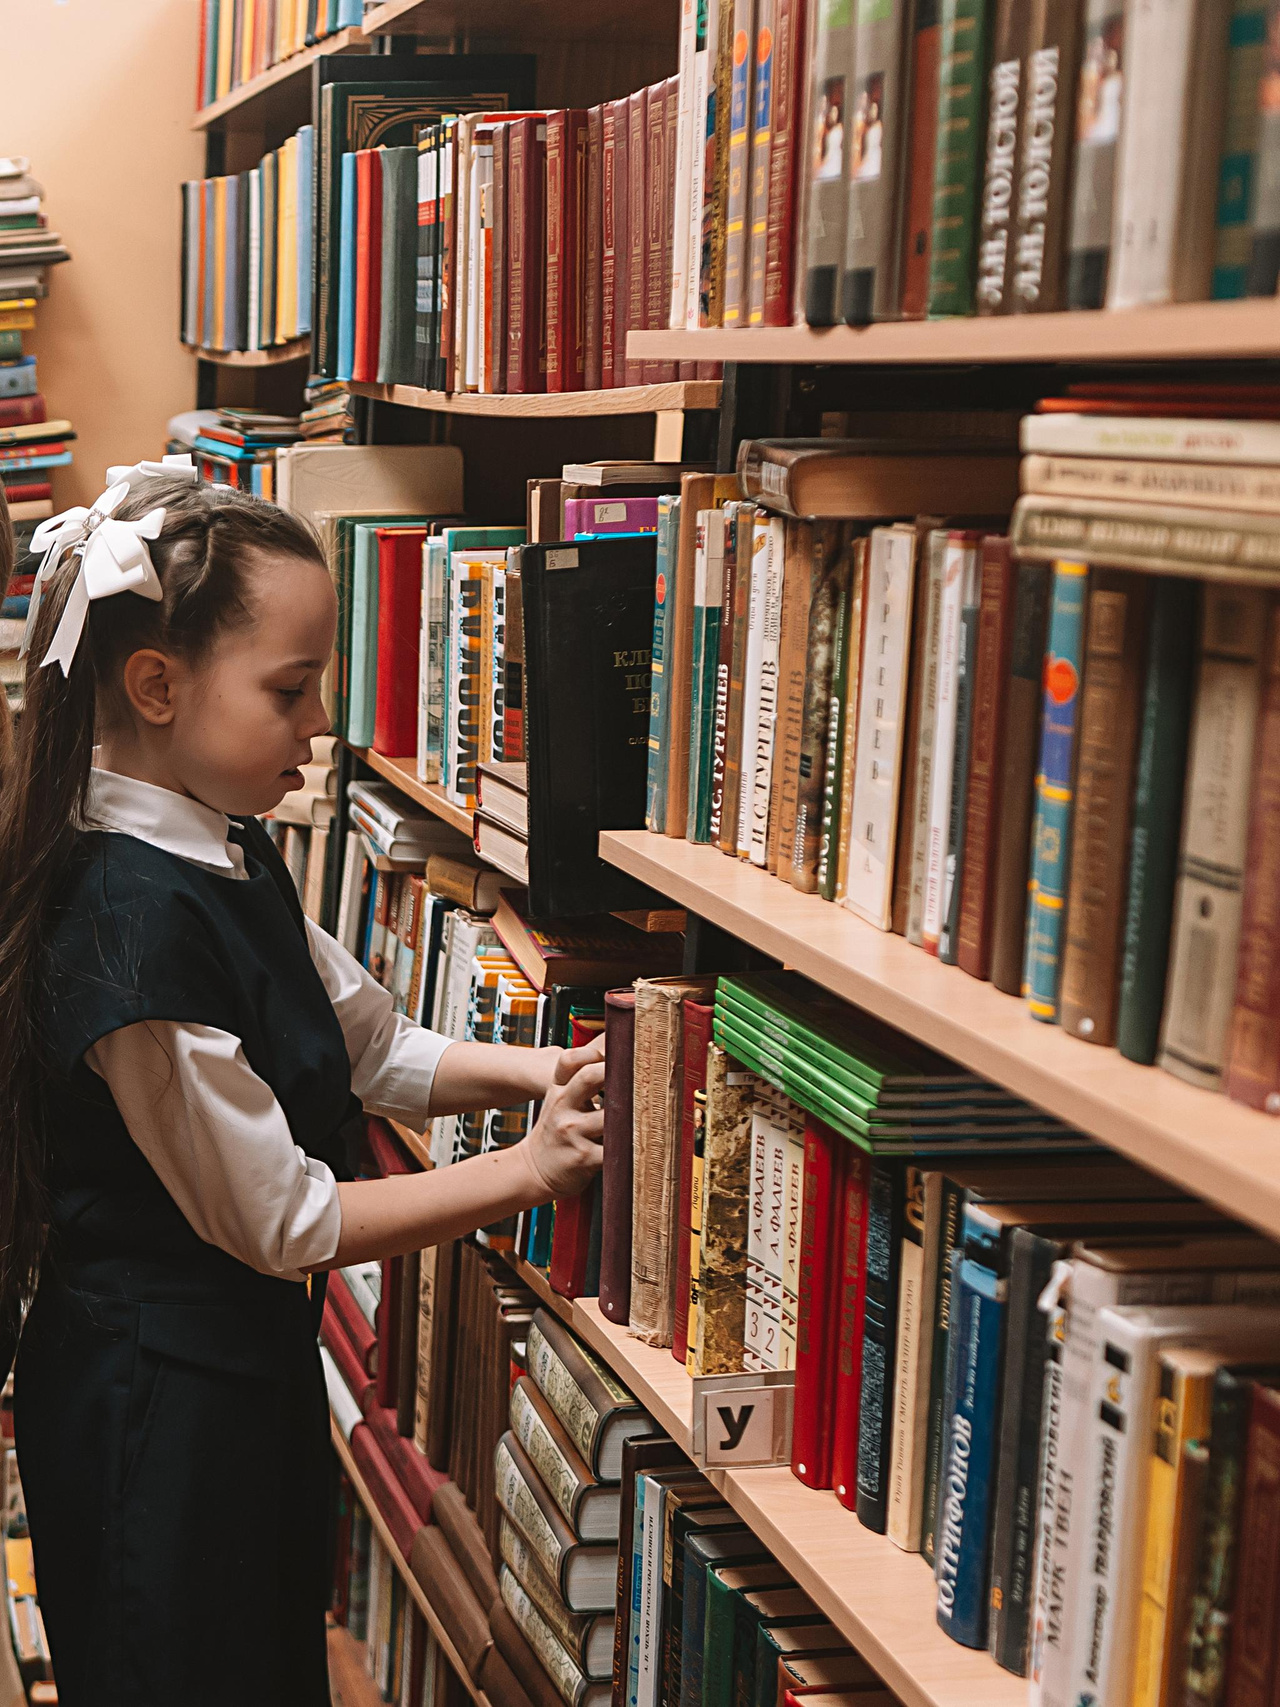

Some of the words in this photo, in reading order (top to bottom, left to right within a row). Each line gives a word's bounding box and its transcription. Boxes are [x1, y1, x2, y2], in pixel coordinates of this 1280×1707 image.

[695, 76, 705, 119] рассказы
[693, 130, 702, 167] Повести
[982, 58, 1021, 226] ТОЛСТОЙ
[1017, 45, 1060, 219] ТОЛСТОЙ
[691, 177, 700, 221] КАЗАКИ
[724, 567, 732, 591] дети
[723, 599, 731, 625] Отцы
[748, 606, 757, 630] Отцы
[872, 539, 895, 780] ТУРГЕНЕВ
[711, 663, 729, 782] ТУРГЕНЕВ
[754, 660, 777, 795] ТУРГЕНЕВ
[780, 669, 803, 811] ТУРГЕНЕВ
[710, 788, 723, 835] И.С.
[737, 771, 748, 815] ТУРГЕНЕВ
[736, 819, 745, 842] ИВАН
[929, 826, 941, 873] ТОЛСТОЙ
[926, 877, 937, 925] АЛЕКСЕЙ
[692, 1175, 701, 1210] Лирика
[753, 1134, 766, 1219] ФАДЕЕВ
[769, 1147, 784, 1233] ФАДЕЕВ
[787, 1162, 800, 1249] ФАДЕЕВ
[753, 1222, 763, 1242] А.
[770, 1237, 780, 1256] А.
[801, 1204, 817, 1257] ТВЕН
[842, 1223, 860, 1278] ТВЕН
[787, 1252, 797, 1273] А.
[798, 1262, 815, 1324] МАРК
[839, 1283, 858, 1346] МАРК
[902, 1278, 915, 1333] МУХТАРА
[938, 1277, 952, 1330] ЮРИЙ
[750, 1311, 760, 1338] 3
[764, 1328, 777, 1354] 2
[783, 1346, 789, 1369] 1
[898, 1377, 909, 1425] СМЕРТЬ
[716, 1404, 755, 1451] У
[895, 1428, 906, 1473] Тынянов
[1042, 1365, 1064, 1513] ТАРКОВСКИЙ
[893, 1475, 904, 1505] Юрий
[1052, 1466, 1075, 1549] ТВЕН
[1093, 1432, 1118, 1579] ТВАРДОВСКИЙ
[616, 1555, 625, 1598] Пьесы
[1037, 1523, 1053, 1612] Арсений
[991, 1586, 1004, 1612] 20
[1046, 1564, 1066, 1650] МАРК
[614, 1615, 623, 1653] Чехов
[1084, 1586, 1108, 1686] Александр
